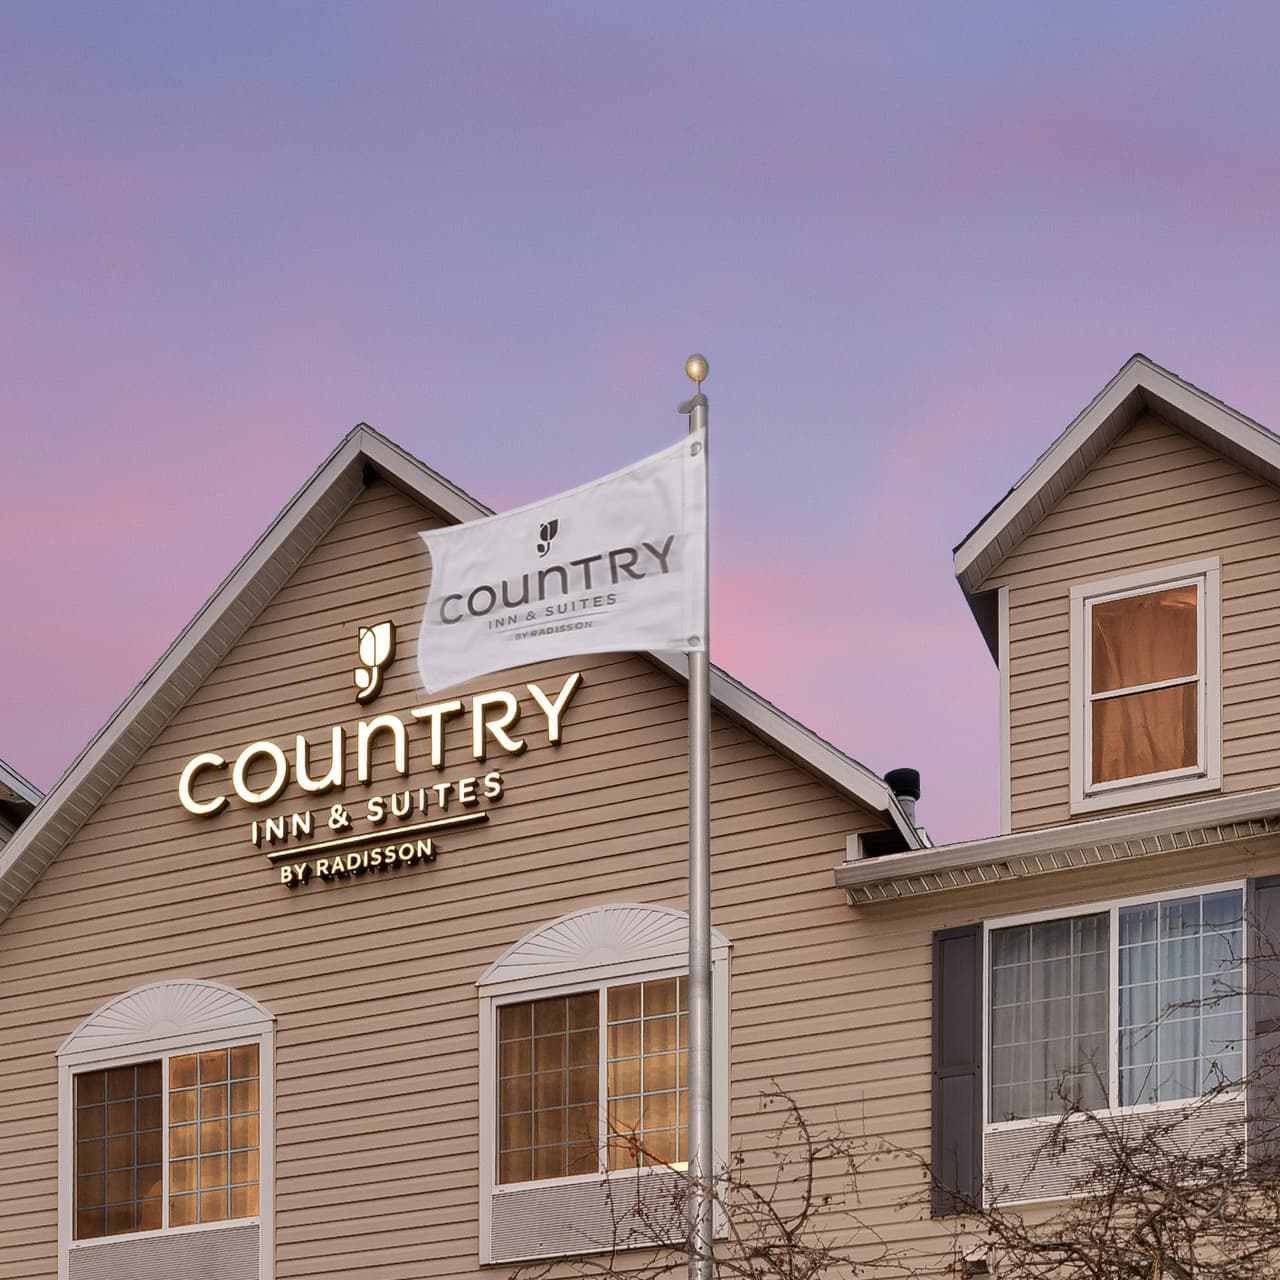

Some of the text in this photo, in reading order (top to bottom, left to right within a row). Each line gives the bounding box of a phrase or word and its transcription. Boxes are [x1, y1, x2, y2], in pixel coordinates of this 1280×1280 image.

[488, 593, 617, 630] INN & SUITES
[515, 621, 593, 640] BY RADISSON
[251, 772, 505, 847] INN & SUITES
[279, 838, 436, 885] BY RADISSON
